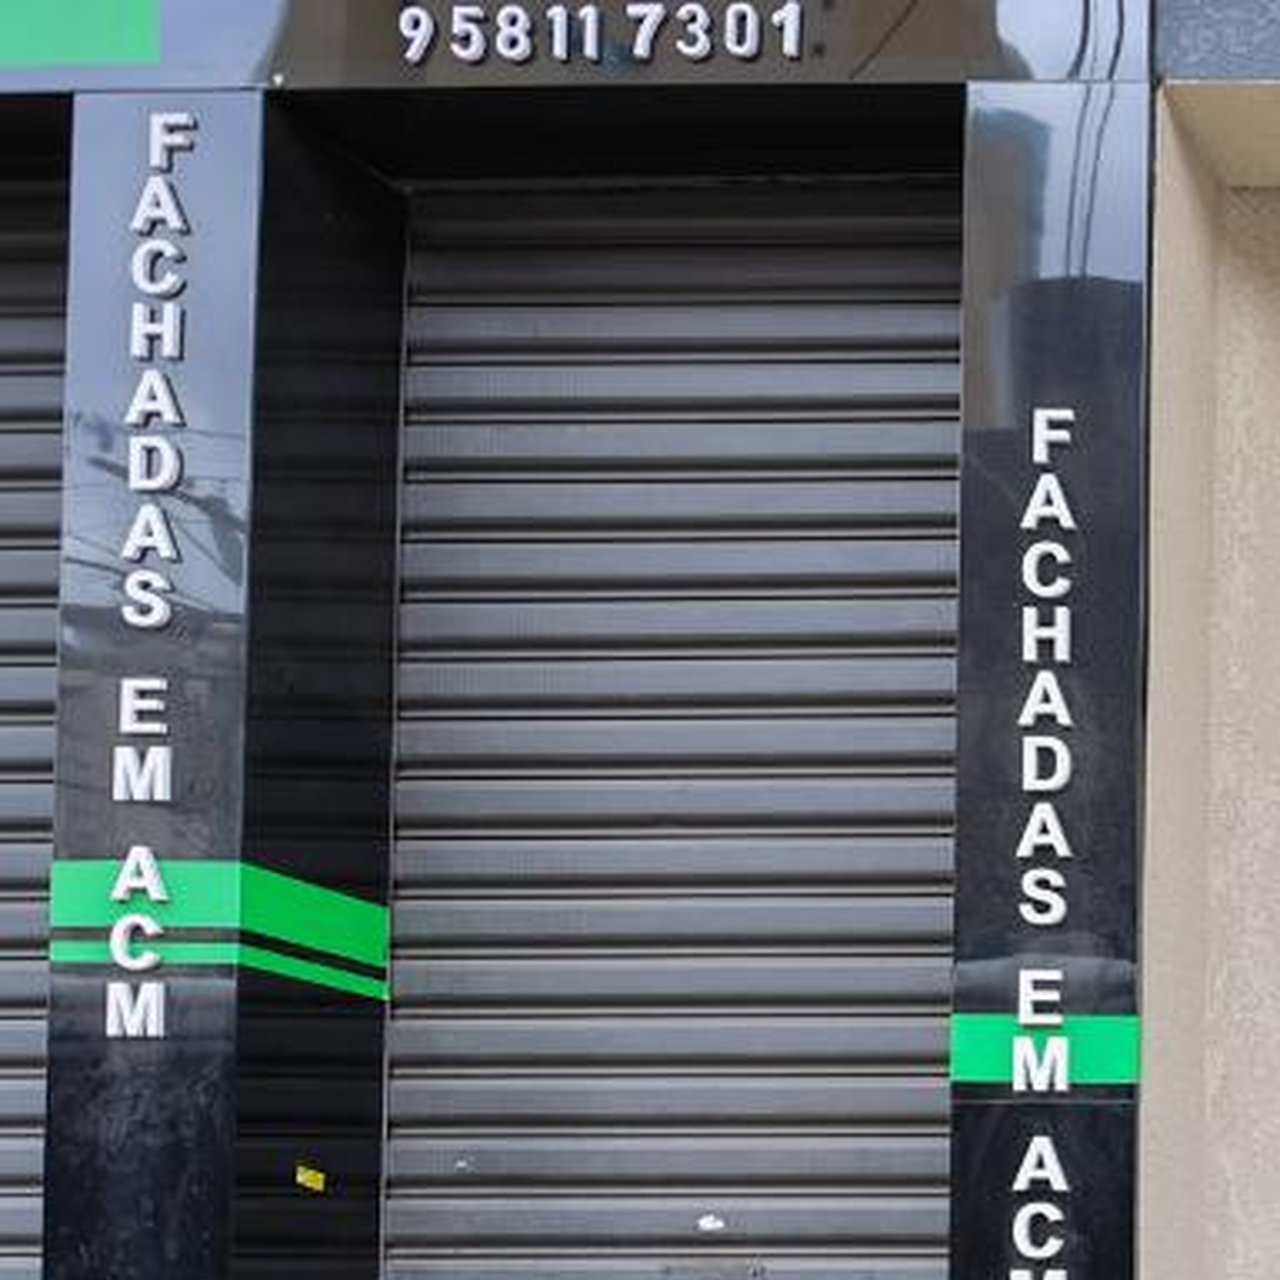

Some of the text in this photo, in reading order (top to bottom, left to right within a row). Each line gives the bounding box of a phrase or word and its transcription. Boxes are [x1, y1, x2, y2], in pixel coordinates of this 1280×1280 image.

[398, 1, 802, 61] 95811 7301
[105, 112, 196, 1037] FACHADAS EM ACM
[1016, 408, 1076, 926] FACHADAS
[1011, 970, 1070, 1092] EM
